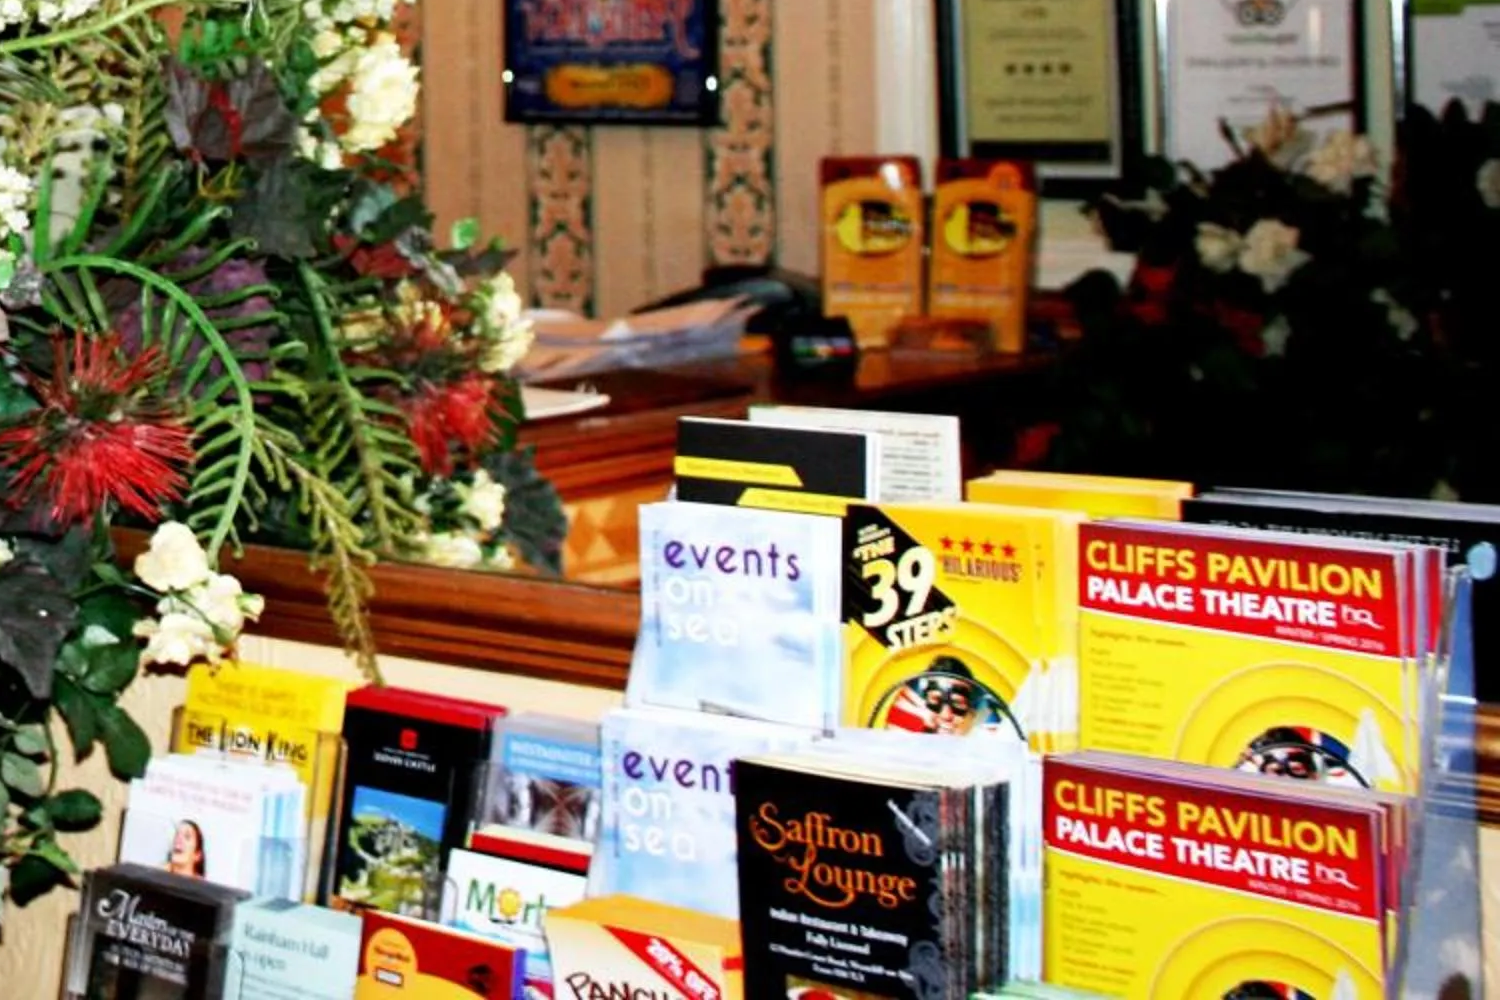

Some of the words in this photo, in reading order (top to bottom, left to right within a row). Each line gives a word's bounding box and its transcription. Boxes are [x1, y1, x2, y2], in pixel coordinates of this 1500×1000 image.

[664, 540, 800, 581] events
[1086, 539, 1196, 581] CLIFFS
[1207, 552, 1383, 599] PAVILION
[665, 575, 713, 607] on
[862, 545, 936, 628] 39
[1087, 575, 1195, 613] PALACE
[1201, 588, 1337, 628] THEATRE
[667, 614, 740, 647] sea
[886, 606, 957, 649] STEPS
[187, 721, 213, 746] THE
[219, 716, 260, 752] LION
[265, 731, 308, 762] KING
[623, 751, 737, 795] event
[624, 787, 671, 820] on
[1054, 780, 1166, 827] CLIFFS
[1177, 801, 1358, 859] PAVILION
[625, 823, 696, 861] sea
[749, 801, 885, 858] Saffron
[1055, 815, 1164, 859] PALACE
[1171, 837, 1311, 885] THEATRE
[784, 845, 918, 909] Lounge
